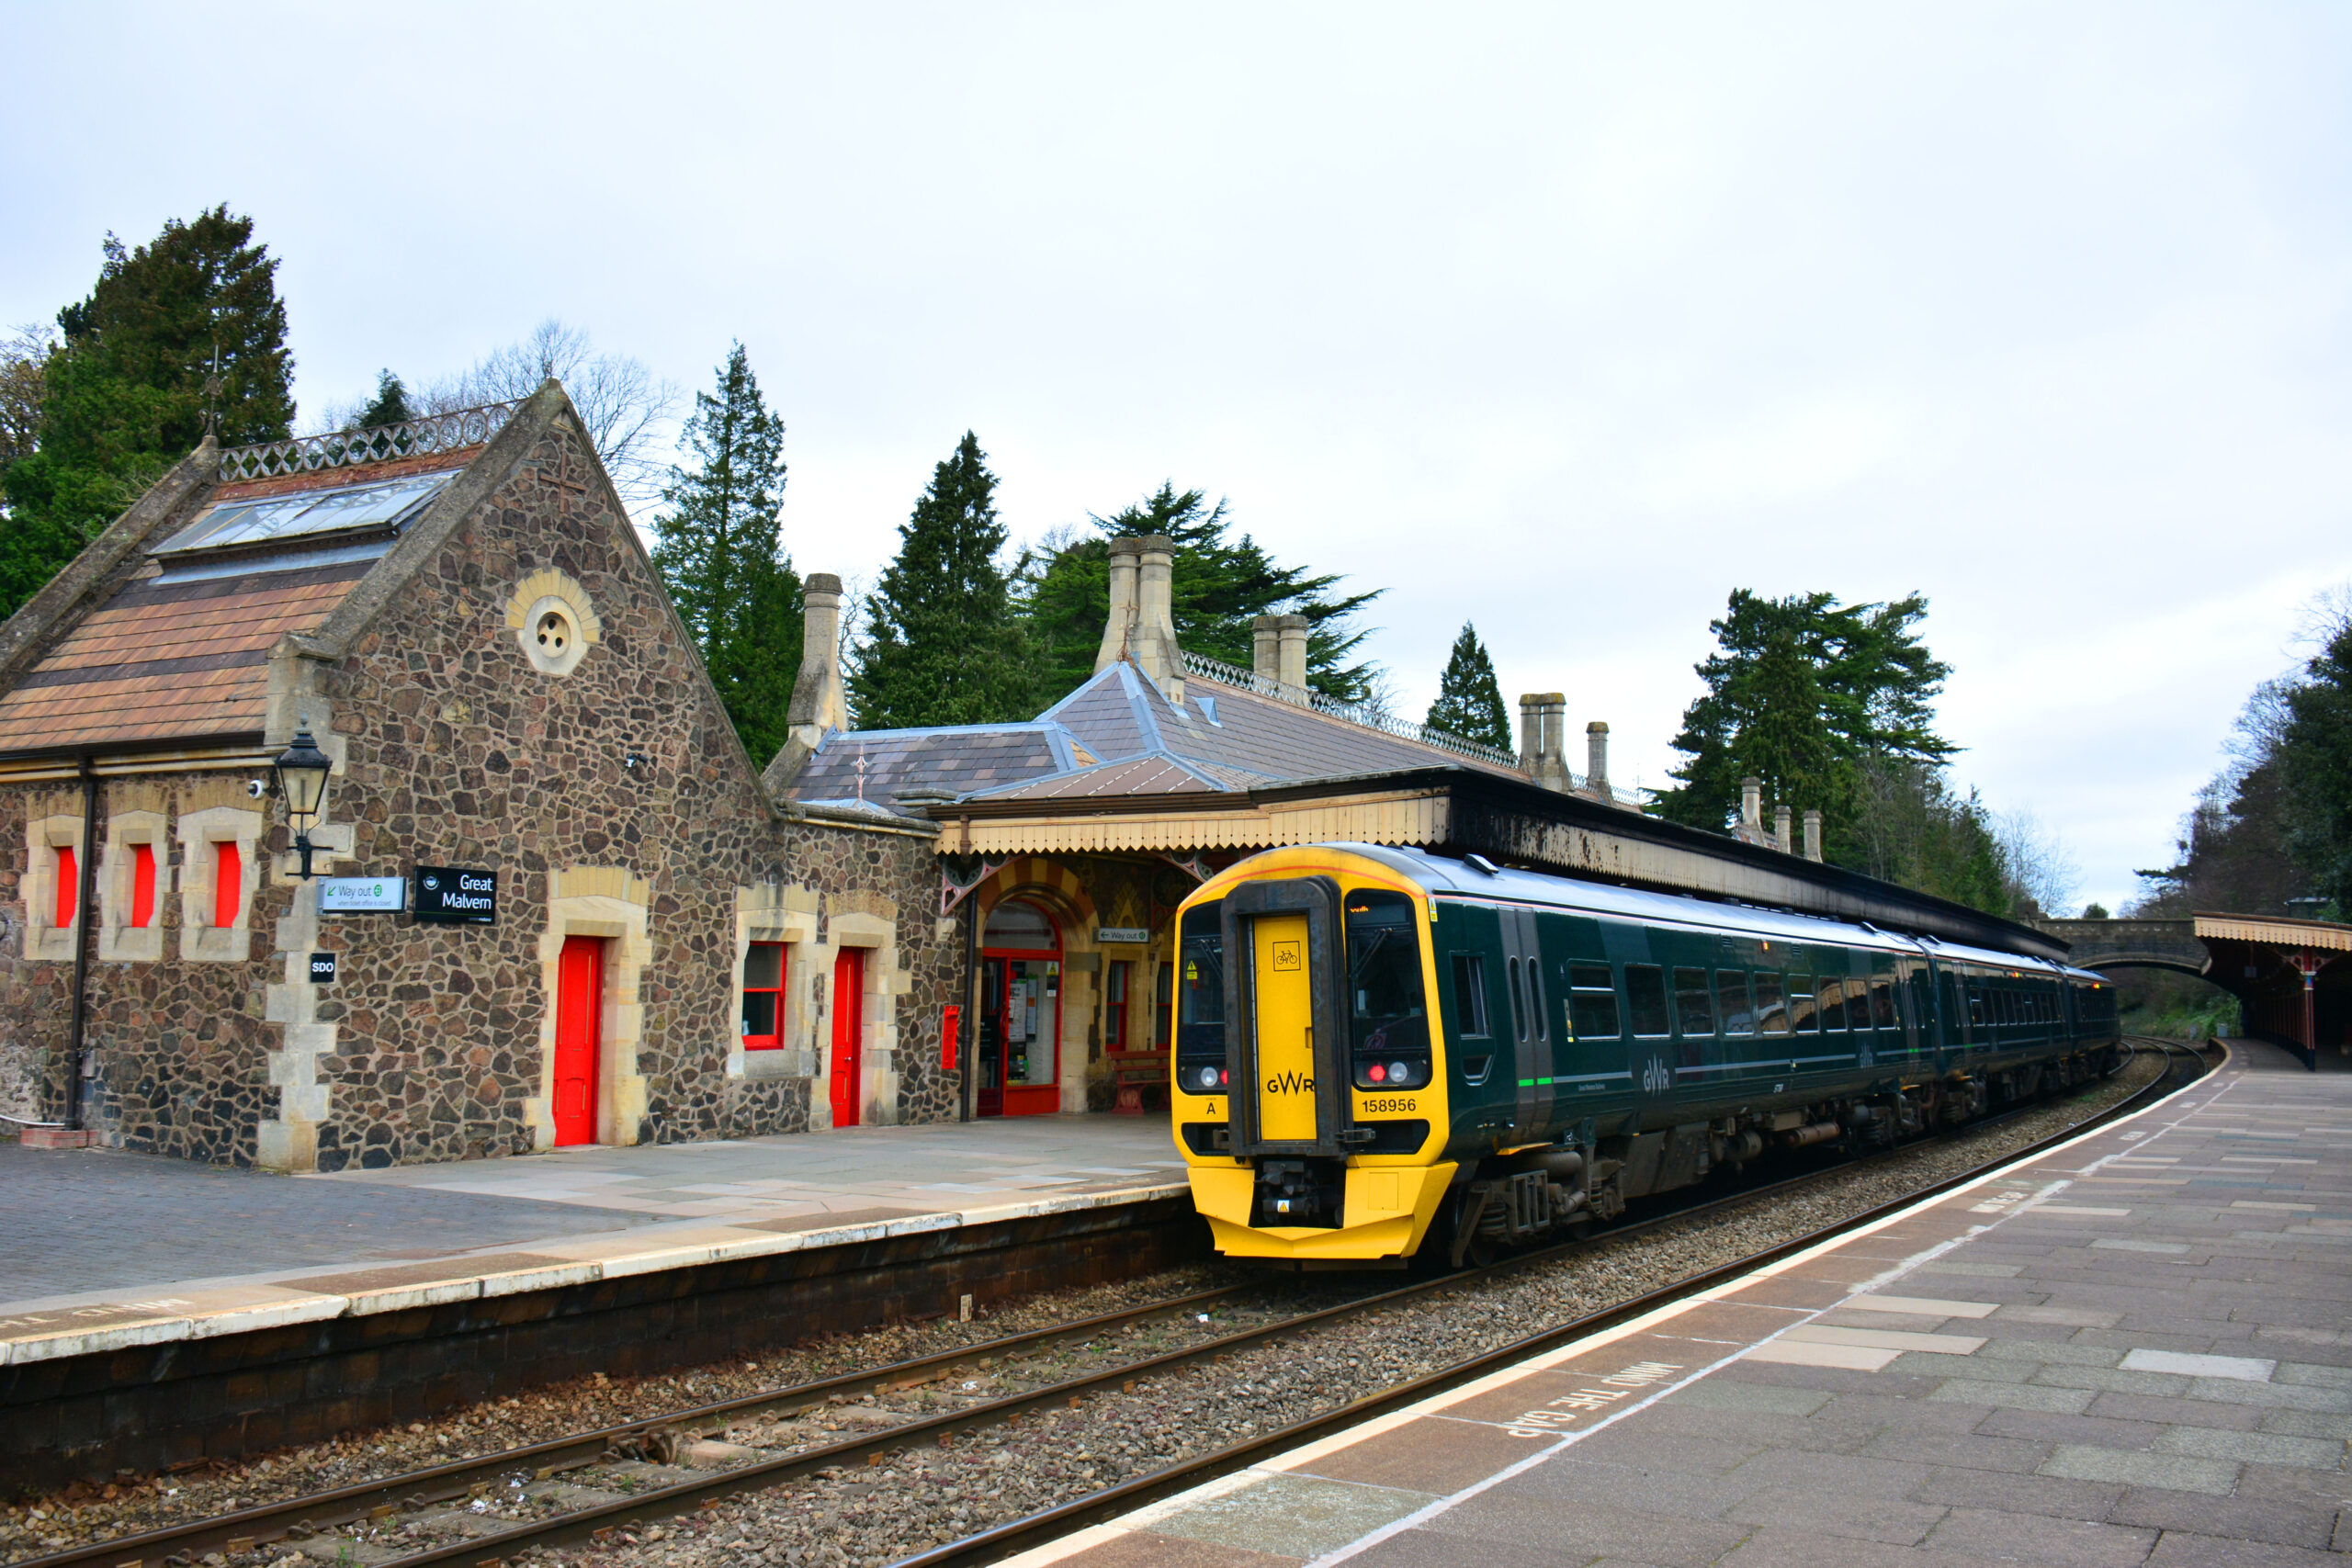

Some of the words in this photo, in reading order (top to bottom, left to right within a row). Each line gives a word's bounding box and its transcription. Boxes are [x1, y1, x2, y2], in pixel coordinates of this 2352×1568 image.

[460, 874, 493, 891] Great
[338, 885, 356, 899] Way
[357, 886, 372, 897] out
[442, 892, 492, 909] Malvern
[1112, 931, 1125, 940] Way
[312, 962, 334, 973] SDO
[1267, 1069, 1315, 1096] GWR
[1643, 1053, 1669, 1095] GWR
[1206, 1102, 1216, 1114] A
[1362, 1099, 1417, 1112] 158956
[72, 1298, 194, 1316] MIND
[1600, 1361, 1685, 1387] MIND
[1546, 1388, 1633, 1411] THE
[1503, 1410, 1577, 1438] GAP
